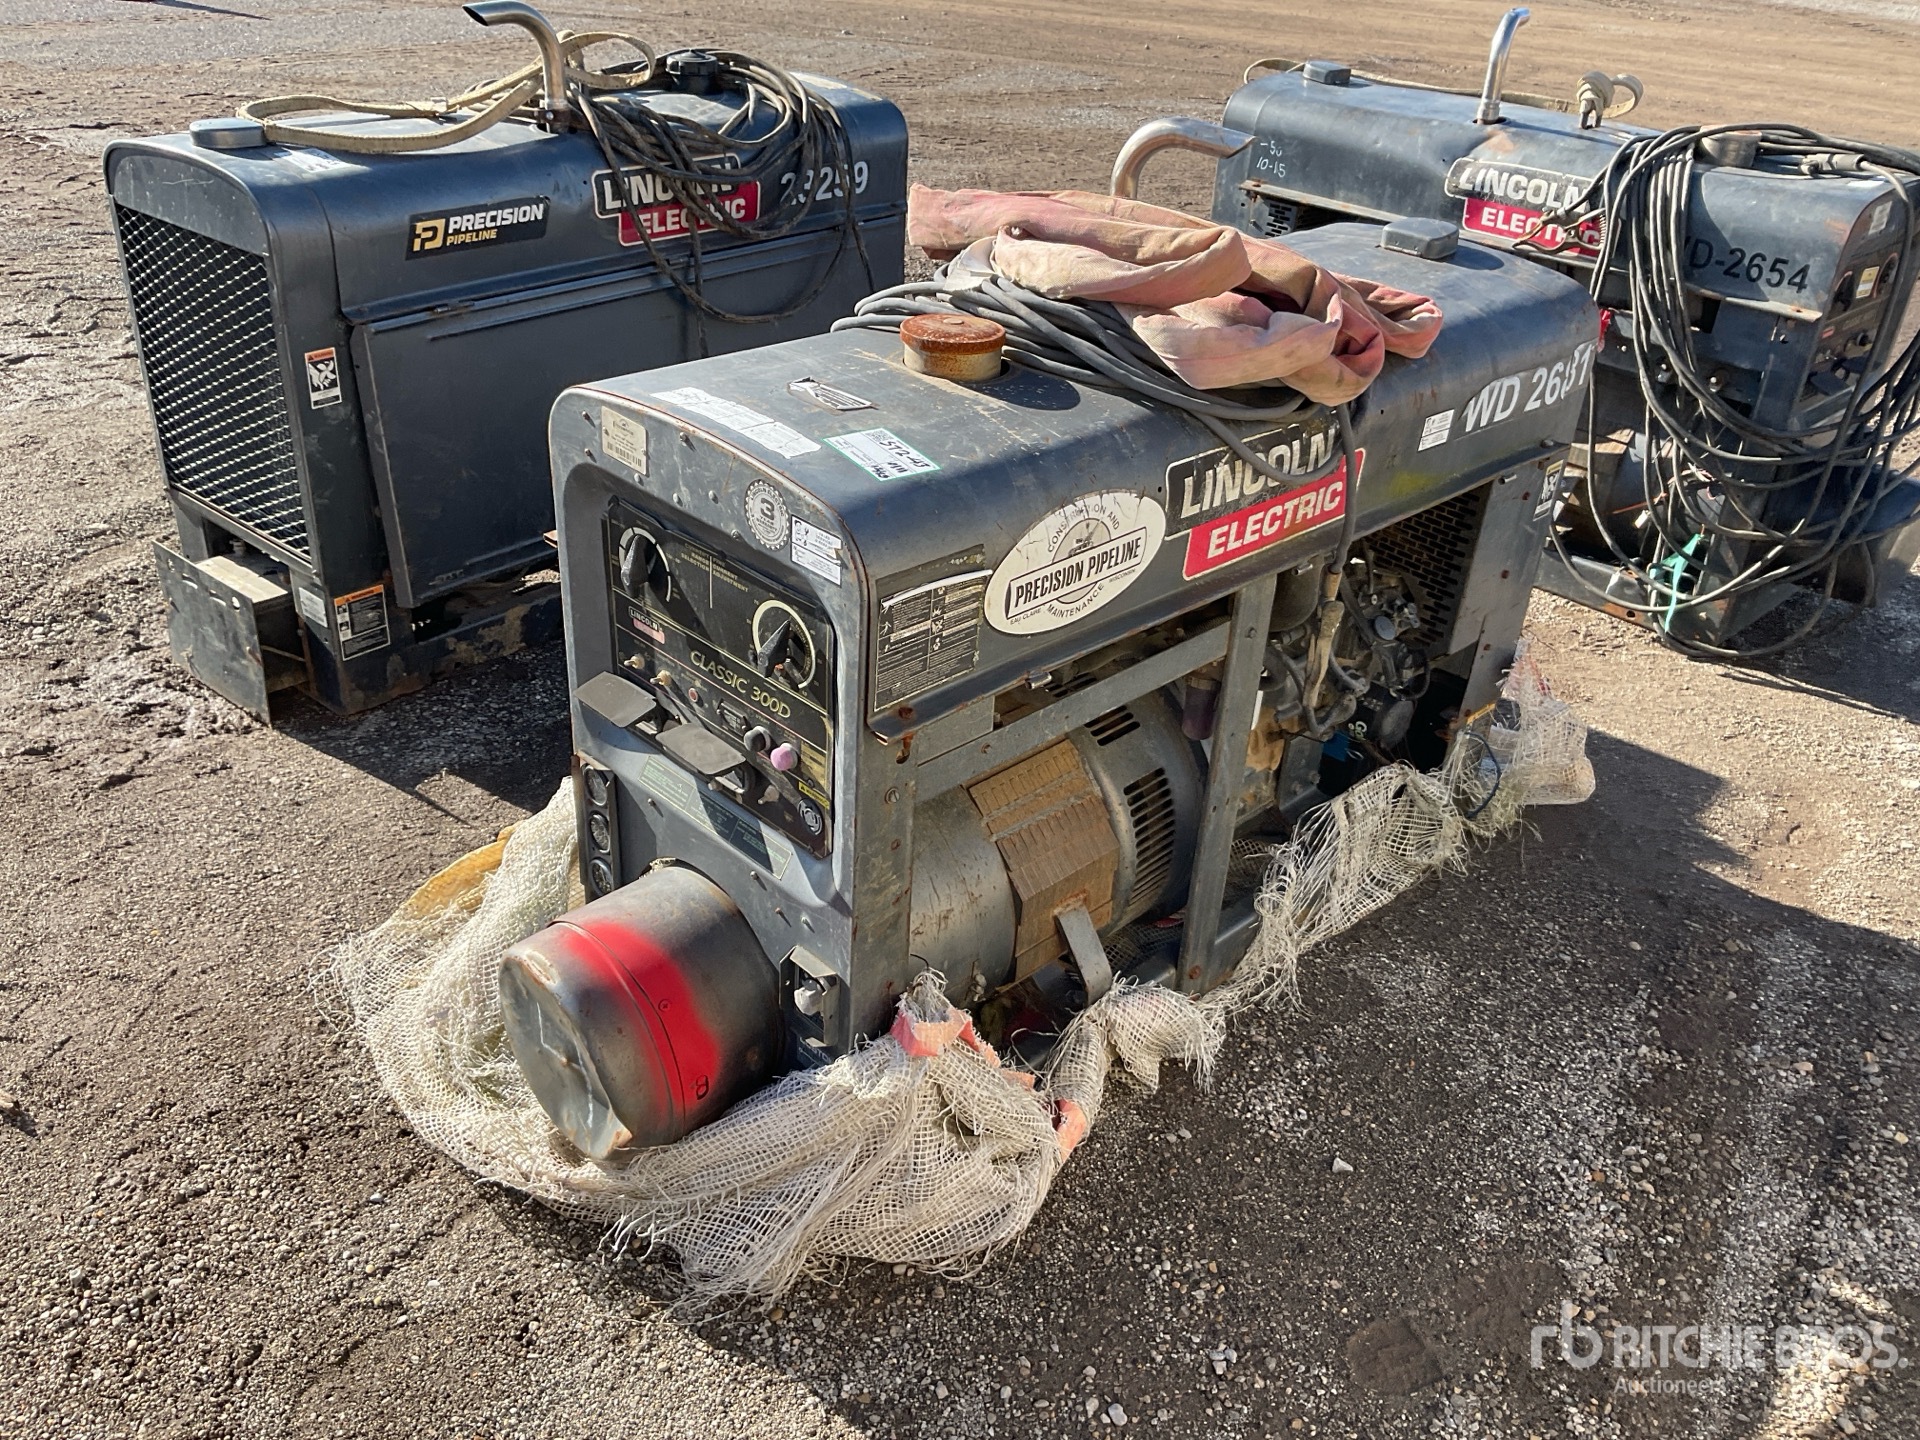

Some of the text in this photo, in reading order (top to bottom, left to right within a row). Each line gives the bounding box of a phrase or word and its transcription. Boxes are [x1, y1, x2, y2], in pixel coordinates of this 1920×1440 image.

[1256, 156, 1286, 178] 10-15
[448, 203, 544, 234] PRECISION
[446, 228, 498, 246] PIPELINE
[1461, 376, 1521, 433] WD
[760, 497, 775, 521] 3
[1107, 511, 1121, 531] AND
[1206, 481, 1344, 560] ELECTRIC
[1014, 536, 1142, 608] PRECISION PIPELINE
[1046, 583, 1105, 619] MAINTENANCE
[690, 650, 748, 693] CLASSIC
[750, 686, 791, 718] 300D
